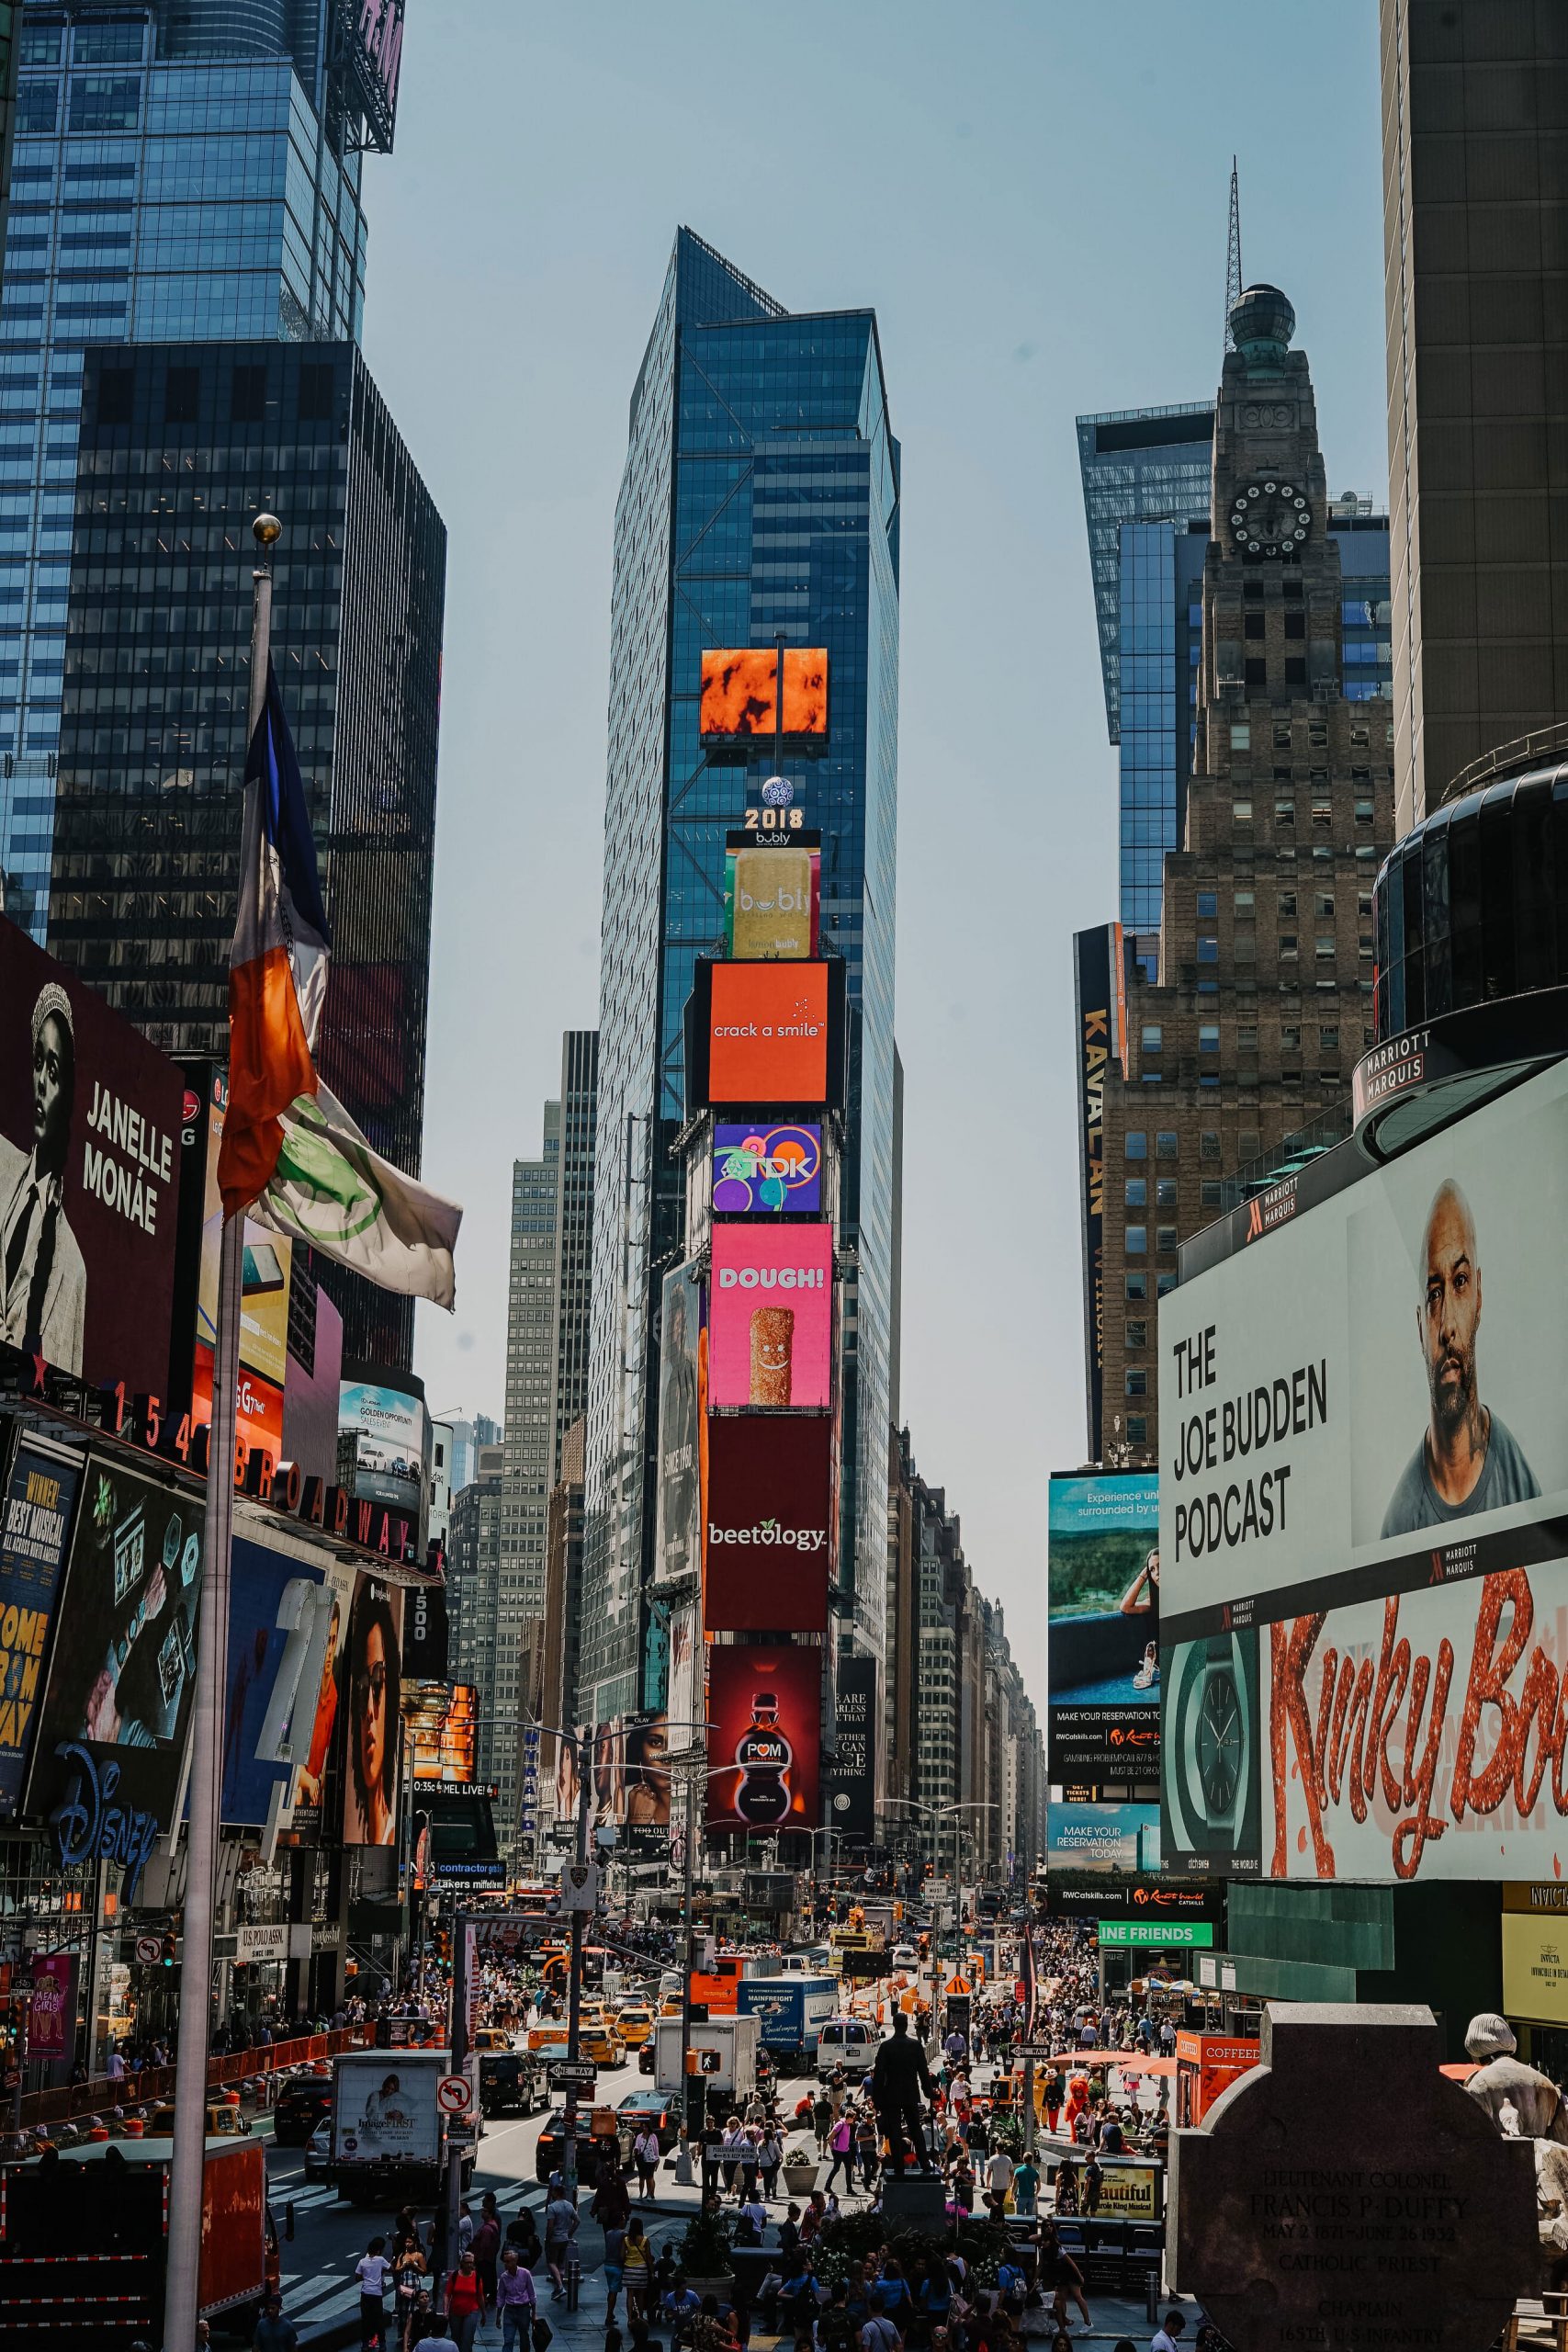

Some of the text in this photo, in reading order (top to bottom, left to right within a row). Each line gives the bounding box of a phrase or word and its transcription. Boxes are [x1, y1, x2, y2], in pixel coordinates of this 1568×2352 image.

[745, 808, 803, 829] 2018
[756, 831, 790, 845] bubly
[714, 1022, 773, 1037] crack a
[1367, 1030, 1431, 1076] MARRIOTT
[1368, 1058, 1421, 1102] MARQUIS
[87, 1080, 173, 1183] JANELLE
[181, 1128, 196, 1146] G
[749, 1157, 814, 1179] TDK
[83, 1141, 157, 1236] MONÁE
[1265, 1177, 1299, 1208] MARRIOTT
[1266, 1197, 1294, 1226] MARQUIS
[719, 1268, 825, 1288] DOUGH!
[1173, 1324, 1216, 1399] THE
[360, 1407, 412, 1426] GOLDEN OPPORTUNITY
[1174, 1358, 1327, 1482] JOE BUDDEN
[26, 1471, 60, 1510] WINNER!
[235, 1434, 410, 1561] BROADWAY
[1088, 1492, 1141, 1504] Experience
[1078, 1504, 1149, 1516] surrounded by
[1175, 1464, 1291, 1564] PODCAST
[6, 1498, 64, 1547] BEST MUSICAL
[3, 1533, 13, 1551] ALL
[1446, 1544, 1477, 1561] MARRIOTT
[1446, 1560, 1473, 1576] MARQUIS
[1233, 1600, 1255, 1613] MARRIOTT
[1233, 1614, 1253, 1625] MARQUIS
[843, 1693, 866, 1704] ARE
[843, 1713, 866, 1722] THAT
[1057, 1712, 1078, 1721] MAKE
[1079, 1712, 1100, 1721] YOUR
[1102, 1711, 1151, 1721] RESERVATION
[1269, 1593, 1454, 1880] Kinky
[747, 1743, 781, 1757] POM
[841, 1742, 865, 1752] CAN
[1064, 1753, 1135, 1763] GAMBLING PROBLEM? CALL
[1111, 1767, 1126, 1775] MUST
[1127, 1767, 1134, 1775] BE
[1135, 1767, 1142, 1775] 21
[462, 1783, 486, 1796] LIVE!
[58, 1743, 159, 1907] Disney
[1065, 1826, 1122, 1837] MAKE YOUR
[1057, 1837, 1122, 1847] RESERVATION
[439, 1863, 488, 1872] contractor
[1063, 1891, 1122, 1899] RWCatskills.com
[1530, 1885, 1568, 1907] INVICT
[243, 1929, 283, 1946] U.S. POLO ASSN.
[1099, 1928, 1193, 1940] INE FRIENDS
[1540, 1954, 1560, 1963] INVICTA
[1531, 1967, 1557, 1977] INVINCIBLE IN
[37, 1991, 59, 2002] MEAN
[35, 2002, 58, 2012] GIRLS
[1206, 2047, 1259, 2059] COFFEED
[358, 2117, 415, 2129] ImageFIRST
[1264, 2171, 1451, 2190] LIEUTENANT COLONEL
[1100, 2183, 1152, 2202] autiful
[1113, 2202, 1152, 2211] King Musical
[1250, 2194, 1469, 2221] FRANCIS DUFFY
[1263, 2224, 1457, 2242] MAY 2 26 1932
[1279, 2255, 1442, 2274] CATHOLIC PRIEST
[1318, 2300, 1404, 2317] CHAPLAIN
[1280, 2326, 1445, 2345] 165TH INFANTRY
